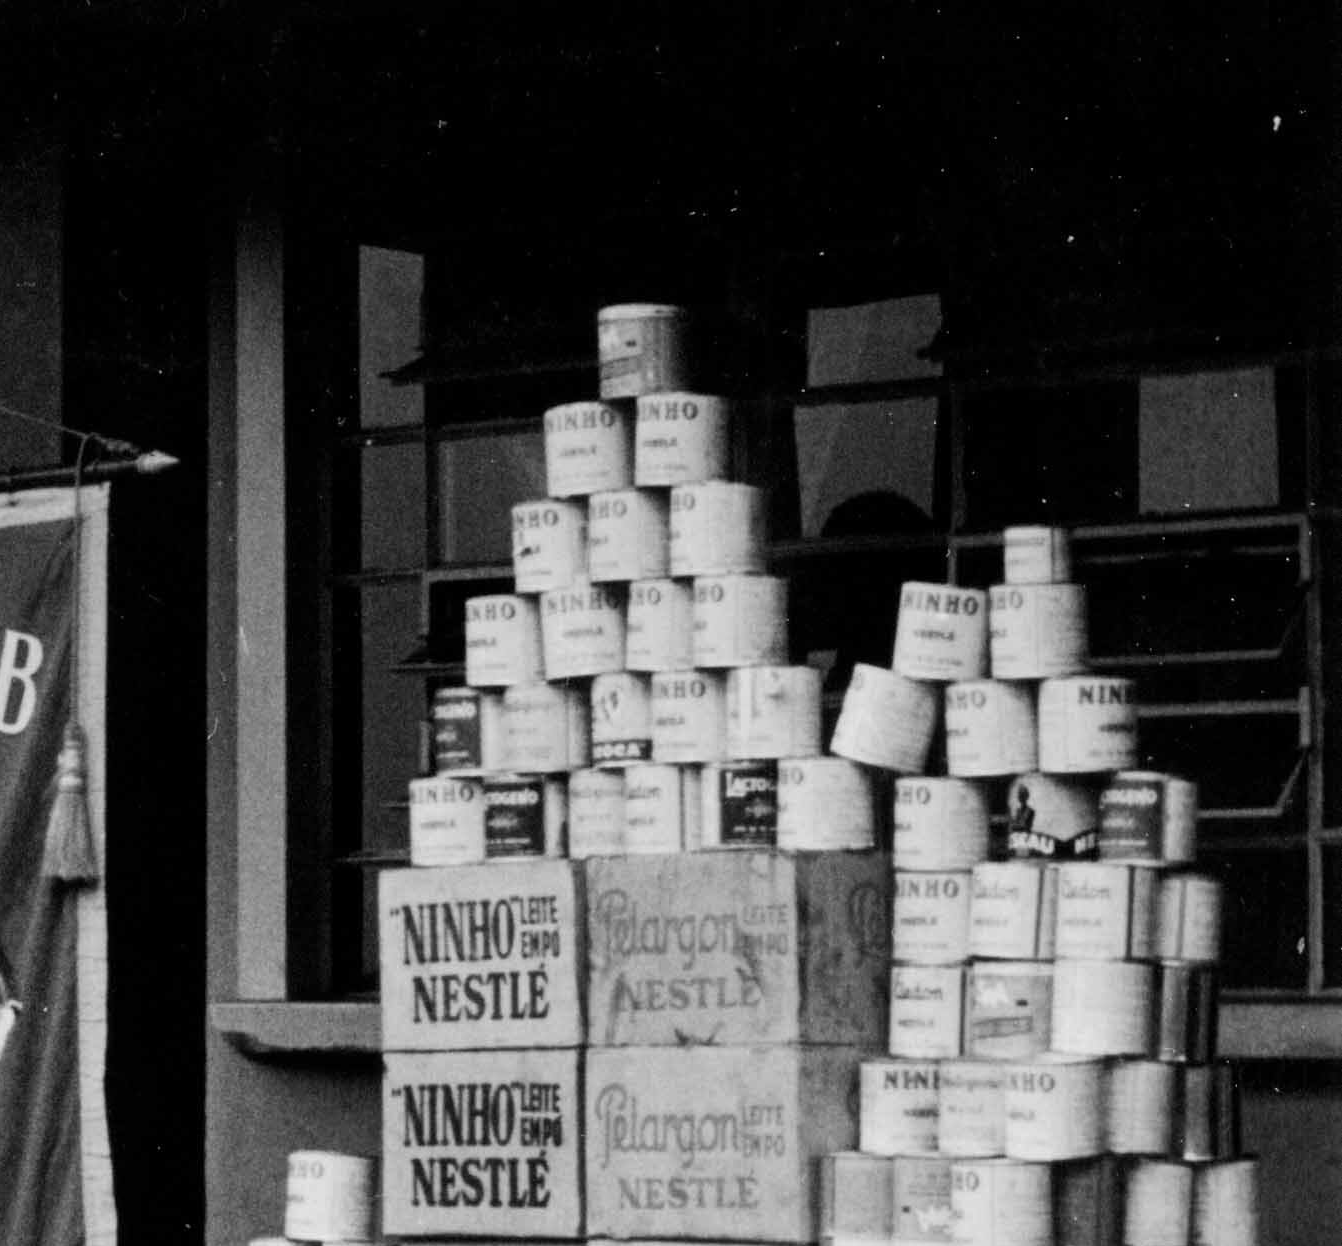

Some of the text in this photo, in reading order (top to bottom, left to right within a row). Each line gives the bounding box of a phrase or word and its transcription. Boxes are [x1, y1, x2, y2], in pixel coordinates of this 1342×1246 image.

[413, 963, 550, 1024] NESTLÉ
[595, 1082, 739, 1169] Pelargon
[411, 1150, 552, 1208] NESTLÉ
[619, 1168, 758, 1209] NESTLÉ
